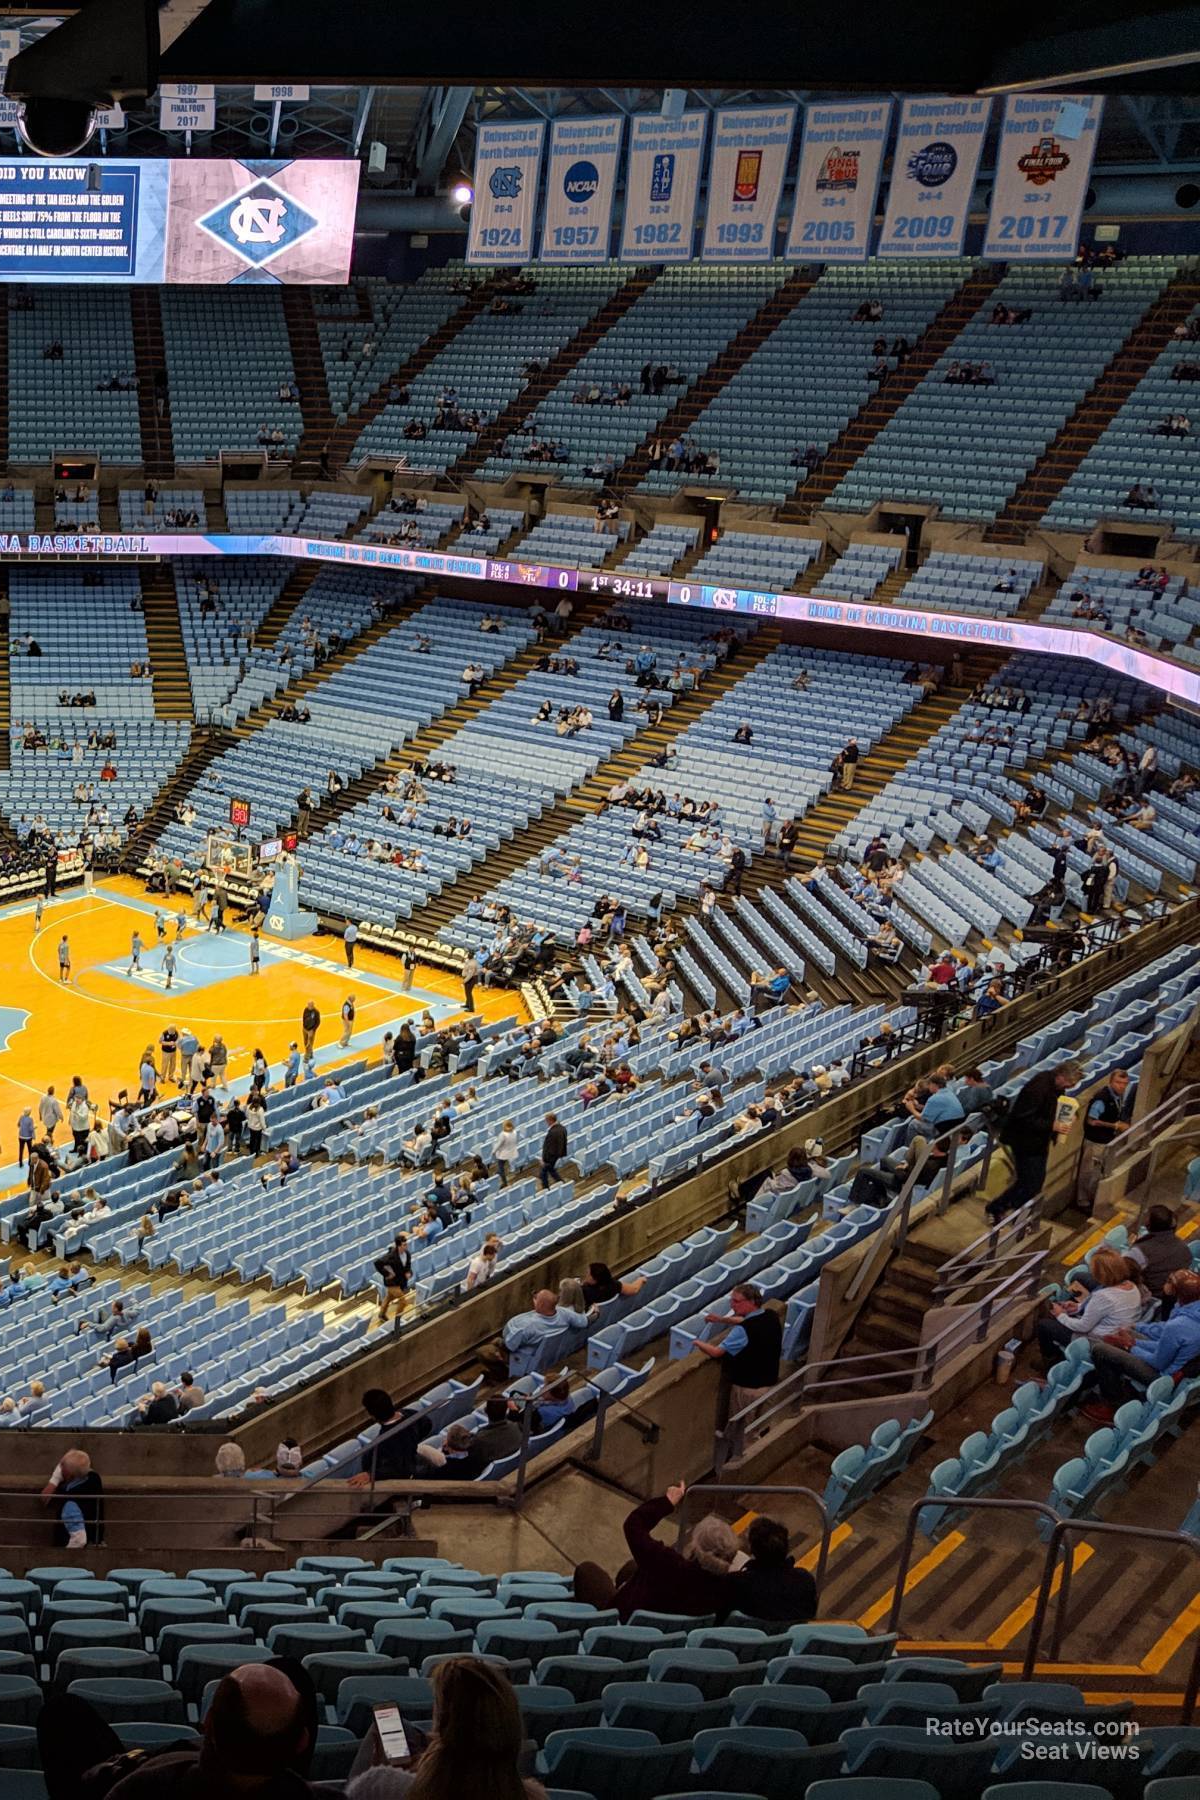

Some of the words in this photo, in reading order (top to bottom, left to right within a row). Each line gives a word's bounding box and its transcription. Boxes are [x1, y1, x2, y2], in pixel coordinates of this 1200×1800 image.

[176, 85, 198, 95] 1997
[270, 87, 293, 98] 1998
[177, 116, 198, 126] 2017
[21, 167, 44, 181] YOU
[49, 168, 87, 181] KNOW
[0, 193, 26, 205] MEETING
[35, 194, 46, 205] THE
[58, 194, 76, 206] HEELS
[90, 194, 101, 206] THE
[102, 194, 124, 206] GOLDEN
[3, 211, 20, 222] HEELS
[54, 211, 71, 222] FROM
[72, 211, 82, 223] THE
[83, 211, 101, 223] FLOOR
[110, 211, 121, 223] THE
[3, 228, 22, 239] WHICH
[30, 228, 46, 239] STILL
[633, 223, 682, 244] 1982
[716, 222, 764, 243] 1993
[802, 220, 856, 241] 2005
[893, 215, 955, 239] 2009
[999, 215, 1069, 239] 2017
[480, 228, 521, 246] 1924
[553, 226, 600, 246] 1957
[38, 245, 53, 256] HALF
[61, 245, 80, 256] SMITH
[81, 245, 102, 256] CENTER
[28, 535, 149, 552] BASKETBALL
[307, 543, 346, 559] WELCOME
[349, 547, 359, 560] TO
[362, 550, 377, 562] THE
[379, 551, 401, 565] DEAN
[415, 556, 444, 569] SMITH
[447, 559, 481, 575] CENTER
[558, 571, 569, 587] 0
[612, 579, 653, 598] 34:11
[680, 587, 691, 603] 0
[770, 605, 776, 613] 0
[809, 603, 842, 619] HOME
[847, 608, 862, 621] OF
[866, 612, 927, 631] CAROLINA
[931, 619, 1013, 642] BASKETBALL
